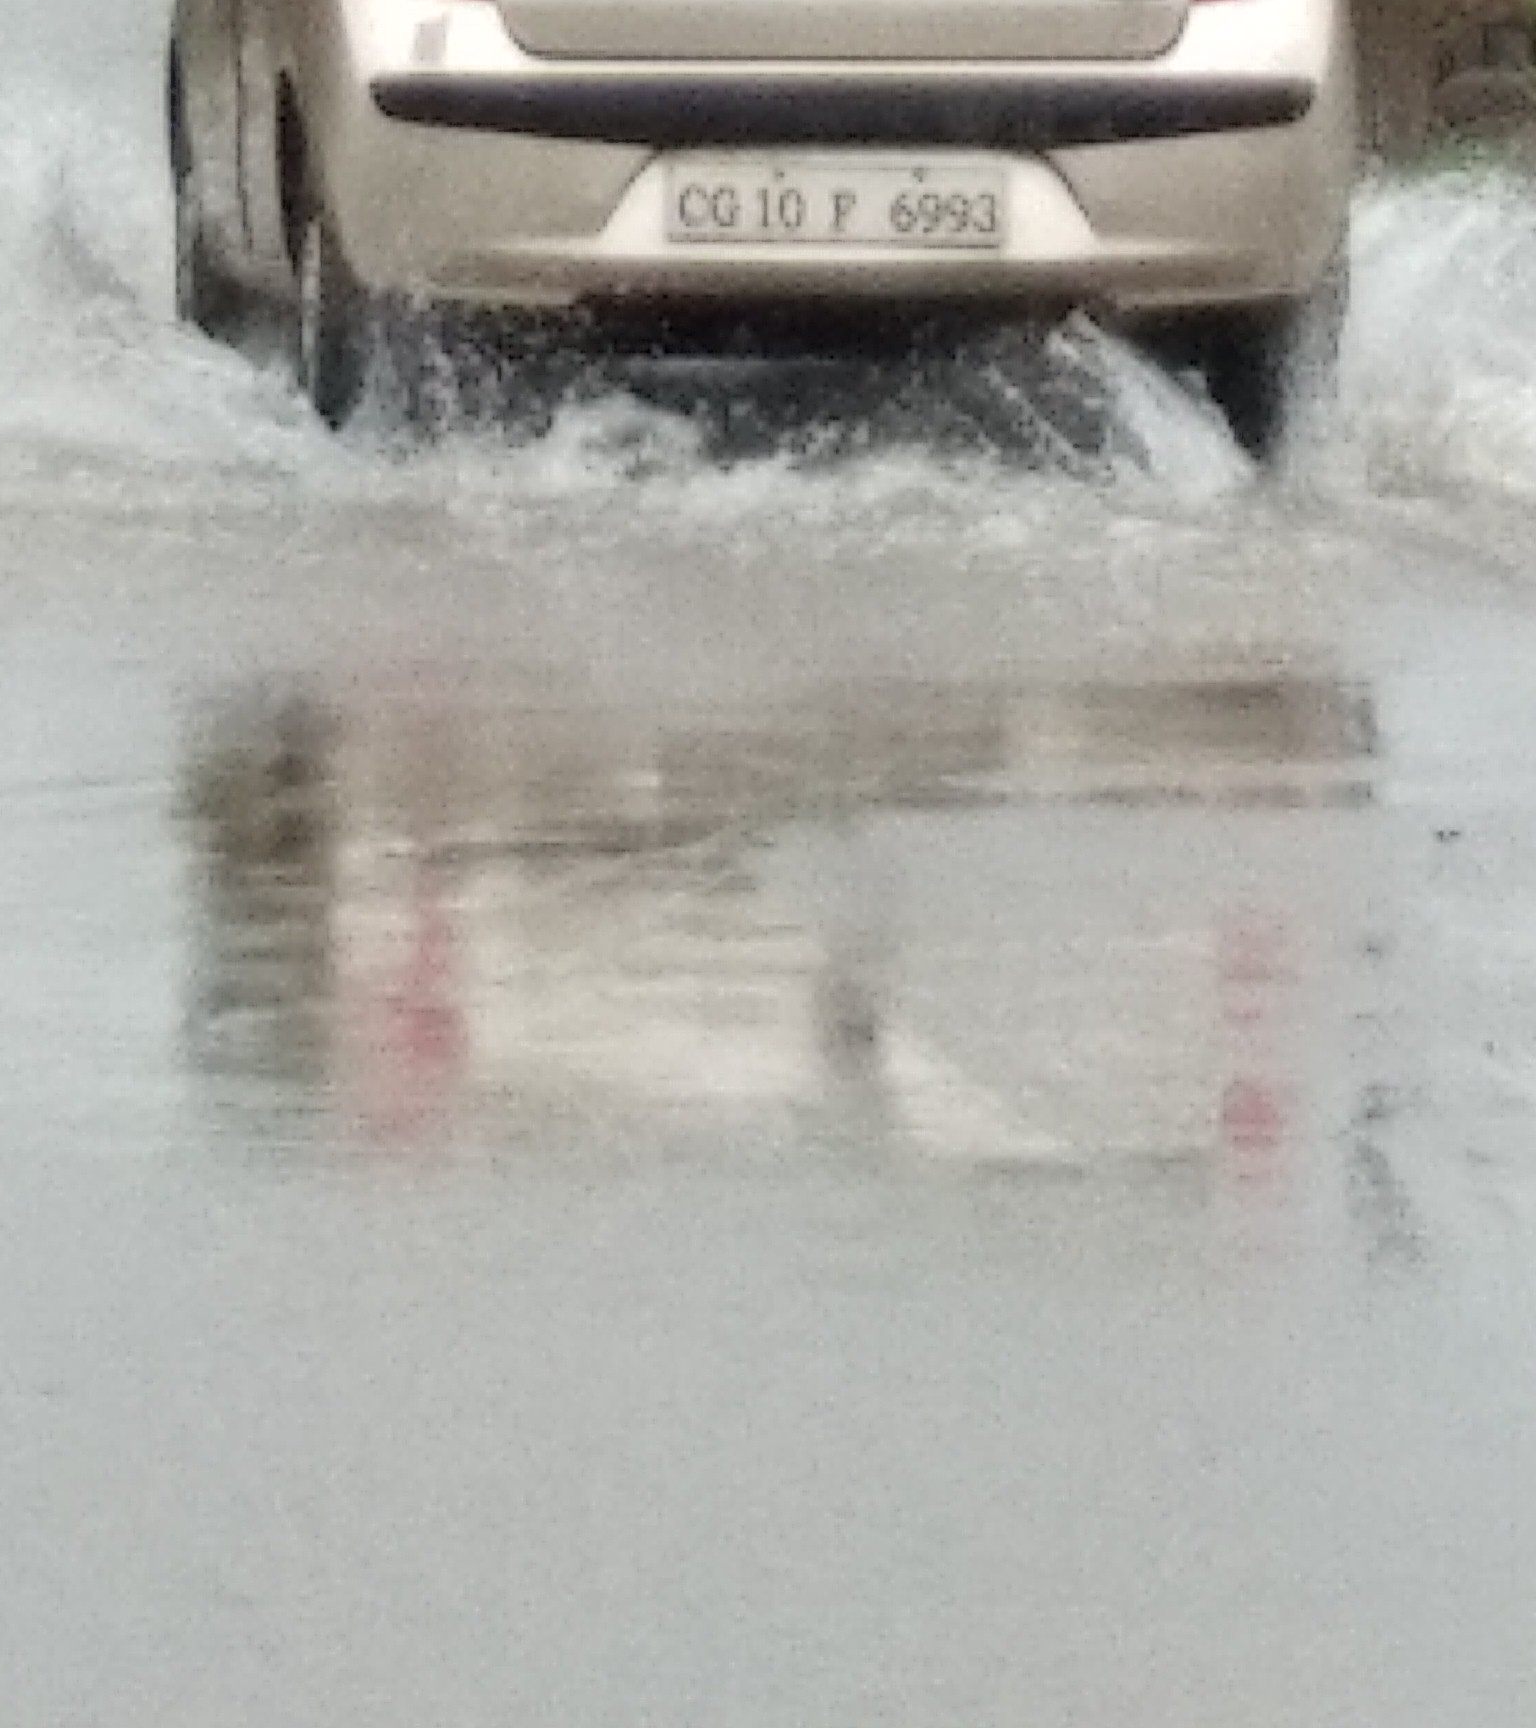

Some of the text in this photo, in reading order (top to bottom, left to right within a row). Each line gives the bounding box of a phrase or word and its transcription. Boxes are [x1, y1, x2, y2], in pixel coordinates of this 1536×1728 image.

[677, 183, 742, 229] CG
[756, 186, 807, 231] 10
[889, 191, 997, 235] 6993
